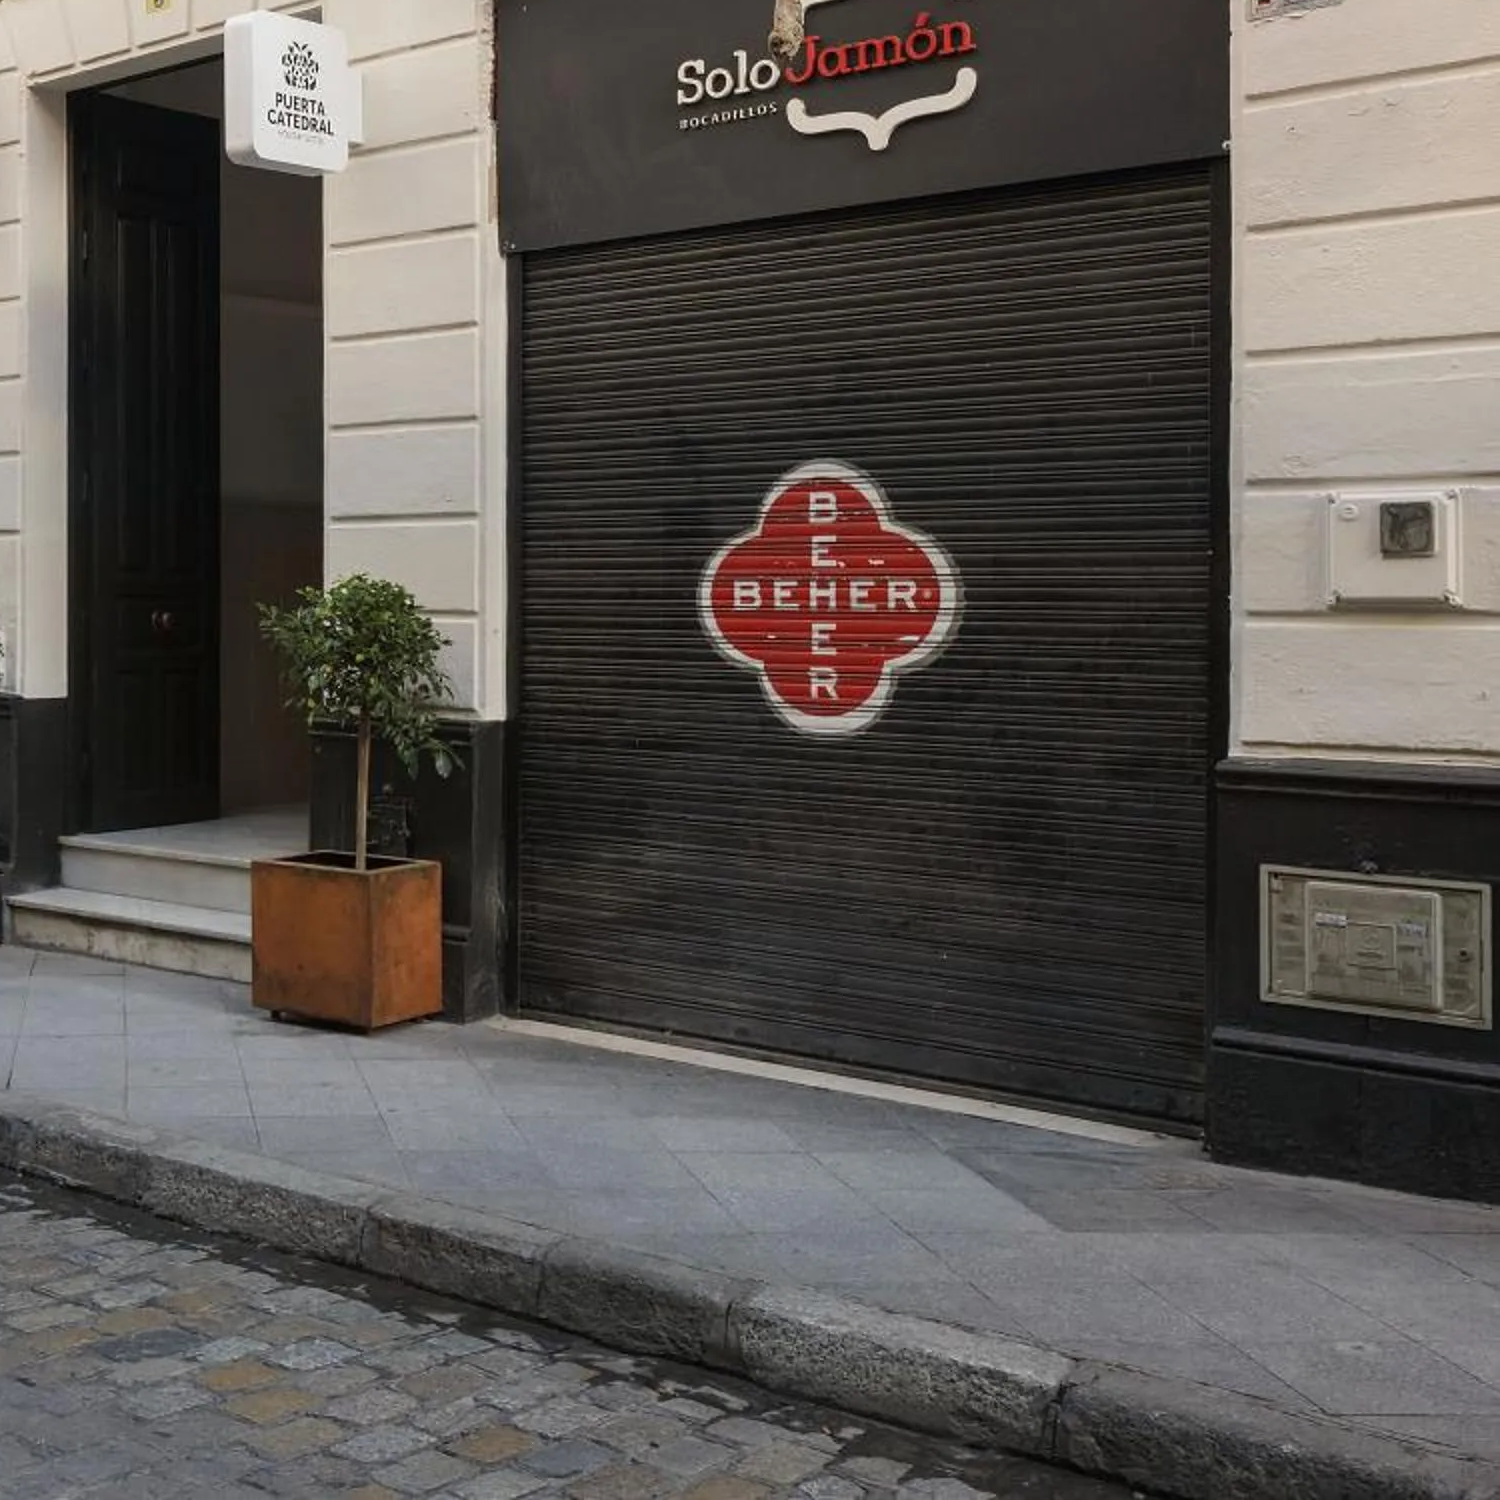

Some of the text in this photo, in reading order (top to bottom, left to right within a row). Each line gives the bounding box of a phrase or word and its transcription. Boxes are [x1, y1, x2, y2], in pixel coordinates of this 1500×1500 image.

[676, 11, 978, 105] Solo Jamón
[275, 91, 326, 116] PUERTA
[678, 101, 779, 130] BOCADILLOS
[267, 108, 335, 137] CATEDRAL
[732, 580, 919, 613] BEHER
[807, 490, 840, 701] BEHER
